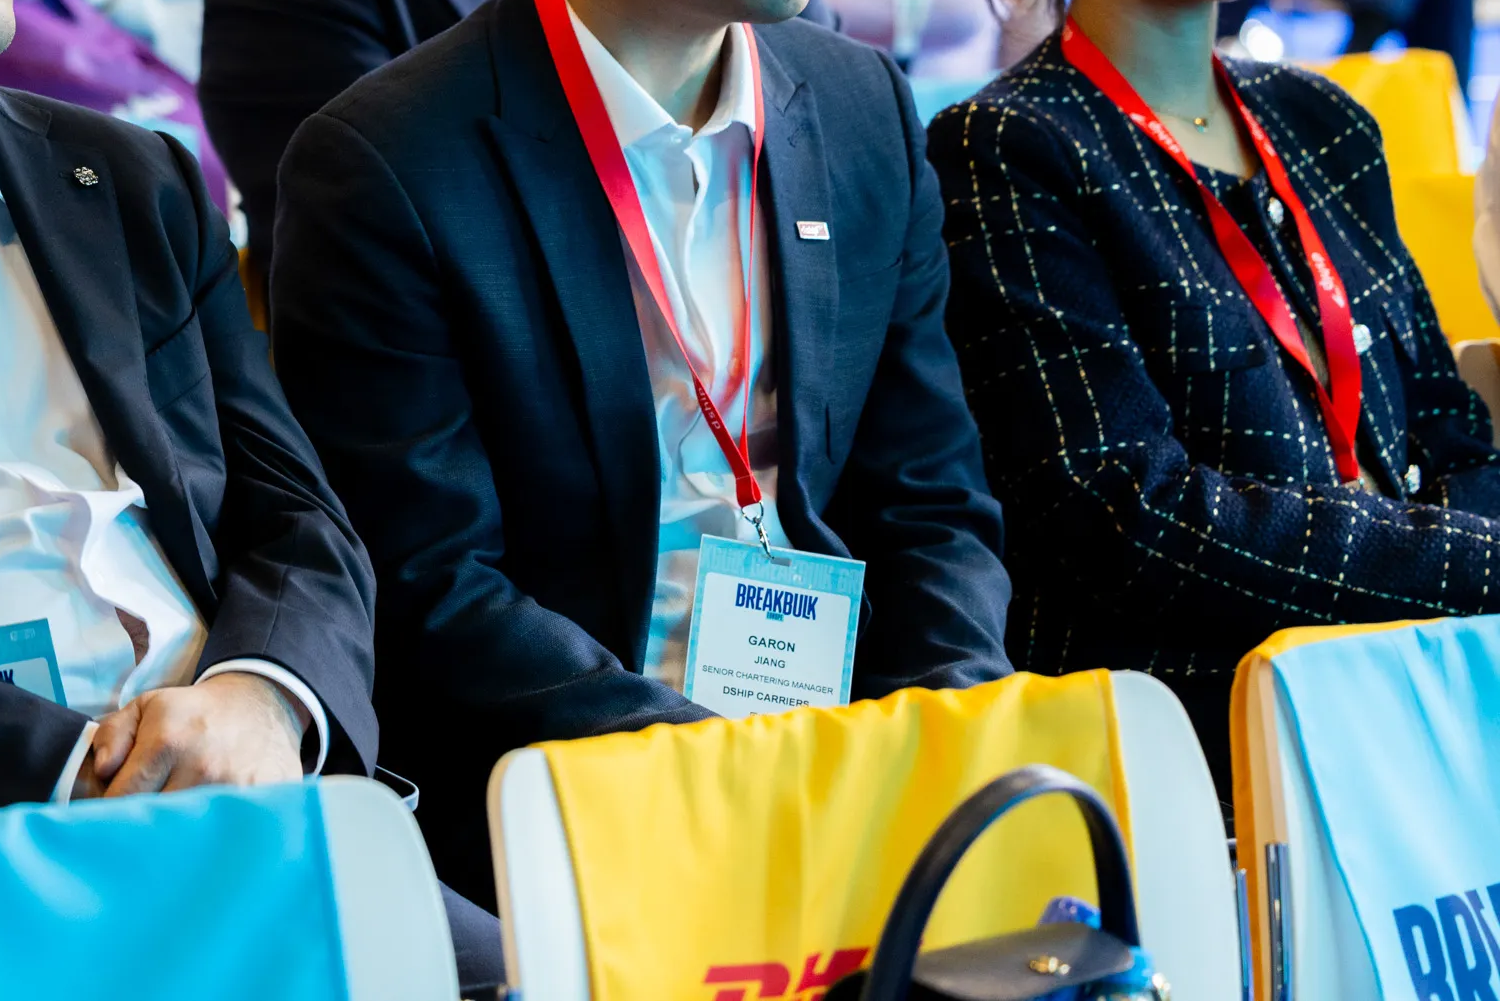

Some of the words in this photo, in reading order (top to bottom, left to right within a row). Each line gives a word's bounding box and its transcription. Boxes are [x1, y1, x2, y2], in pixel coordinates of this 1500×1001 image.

[735, 583, 819, 621] BREAKBULK
[748, 635, 796, 653] GARON
[754, 656, 786, 669] JIANG
[702, 664, 734, 677] SENIOR
[735, 671, 790, 687] CHARTERING
[791, 681, 834, 695] MANAGER
[722, 685, 754, 698] DSHIP
[756, 692, 810, 708] CARRIERS
